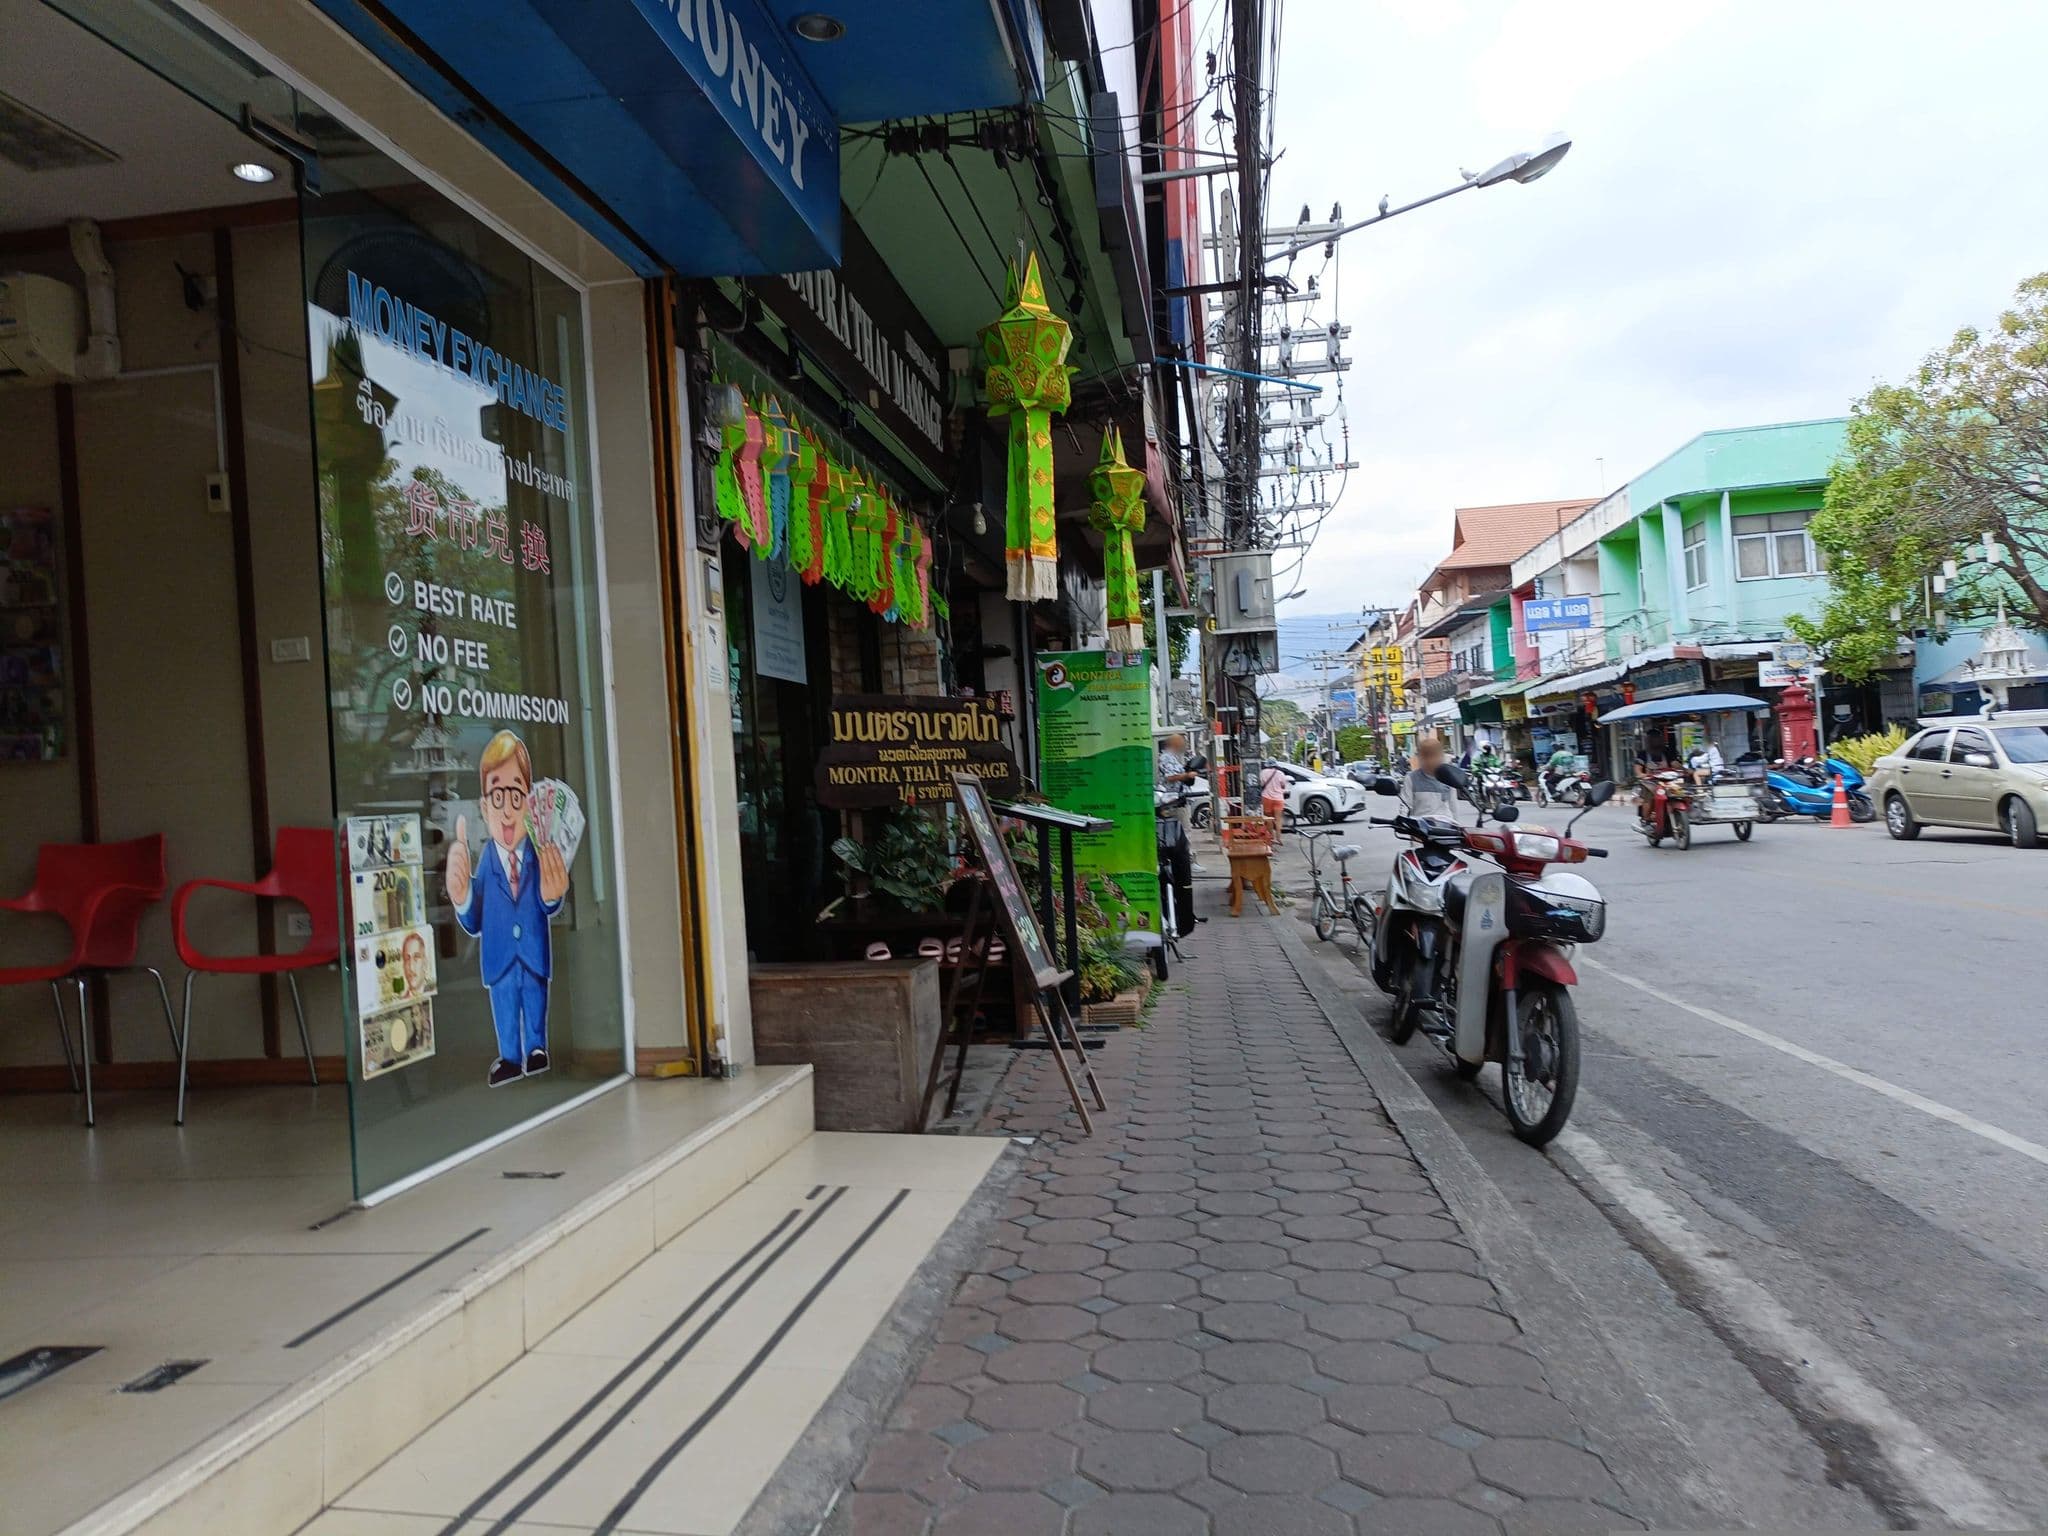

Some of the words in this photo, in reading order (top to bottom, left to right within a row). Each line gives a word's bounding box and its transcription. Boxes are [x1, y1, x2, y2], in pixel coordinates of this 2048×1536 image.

[347, 269, 447, 370] MONEY
[450, 327, 568, 433] EXCHANGE
[848, 292, 892, 395] THAI
[414, 580, 466, 617] BEST
[471, 594, 517, 629] RATE
[417, 632, 449, 664] NO
[454, 640, 490, 670] FEE
[422, 685, 453, 715] NO
[457, 688, 570, 725] COMMISSION
[829, 766, 900, 785] MONTRA
[903, 765, 941, 782] THAI
[945, 762, 1009, 782] MASSAGE
[373, 870, 396, 892] 200
[358, 920, 374, 935] 200
